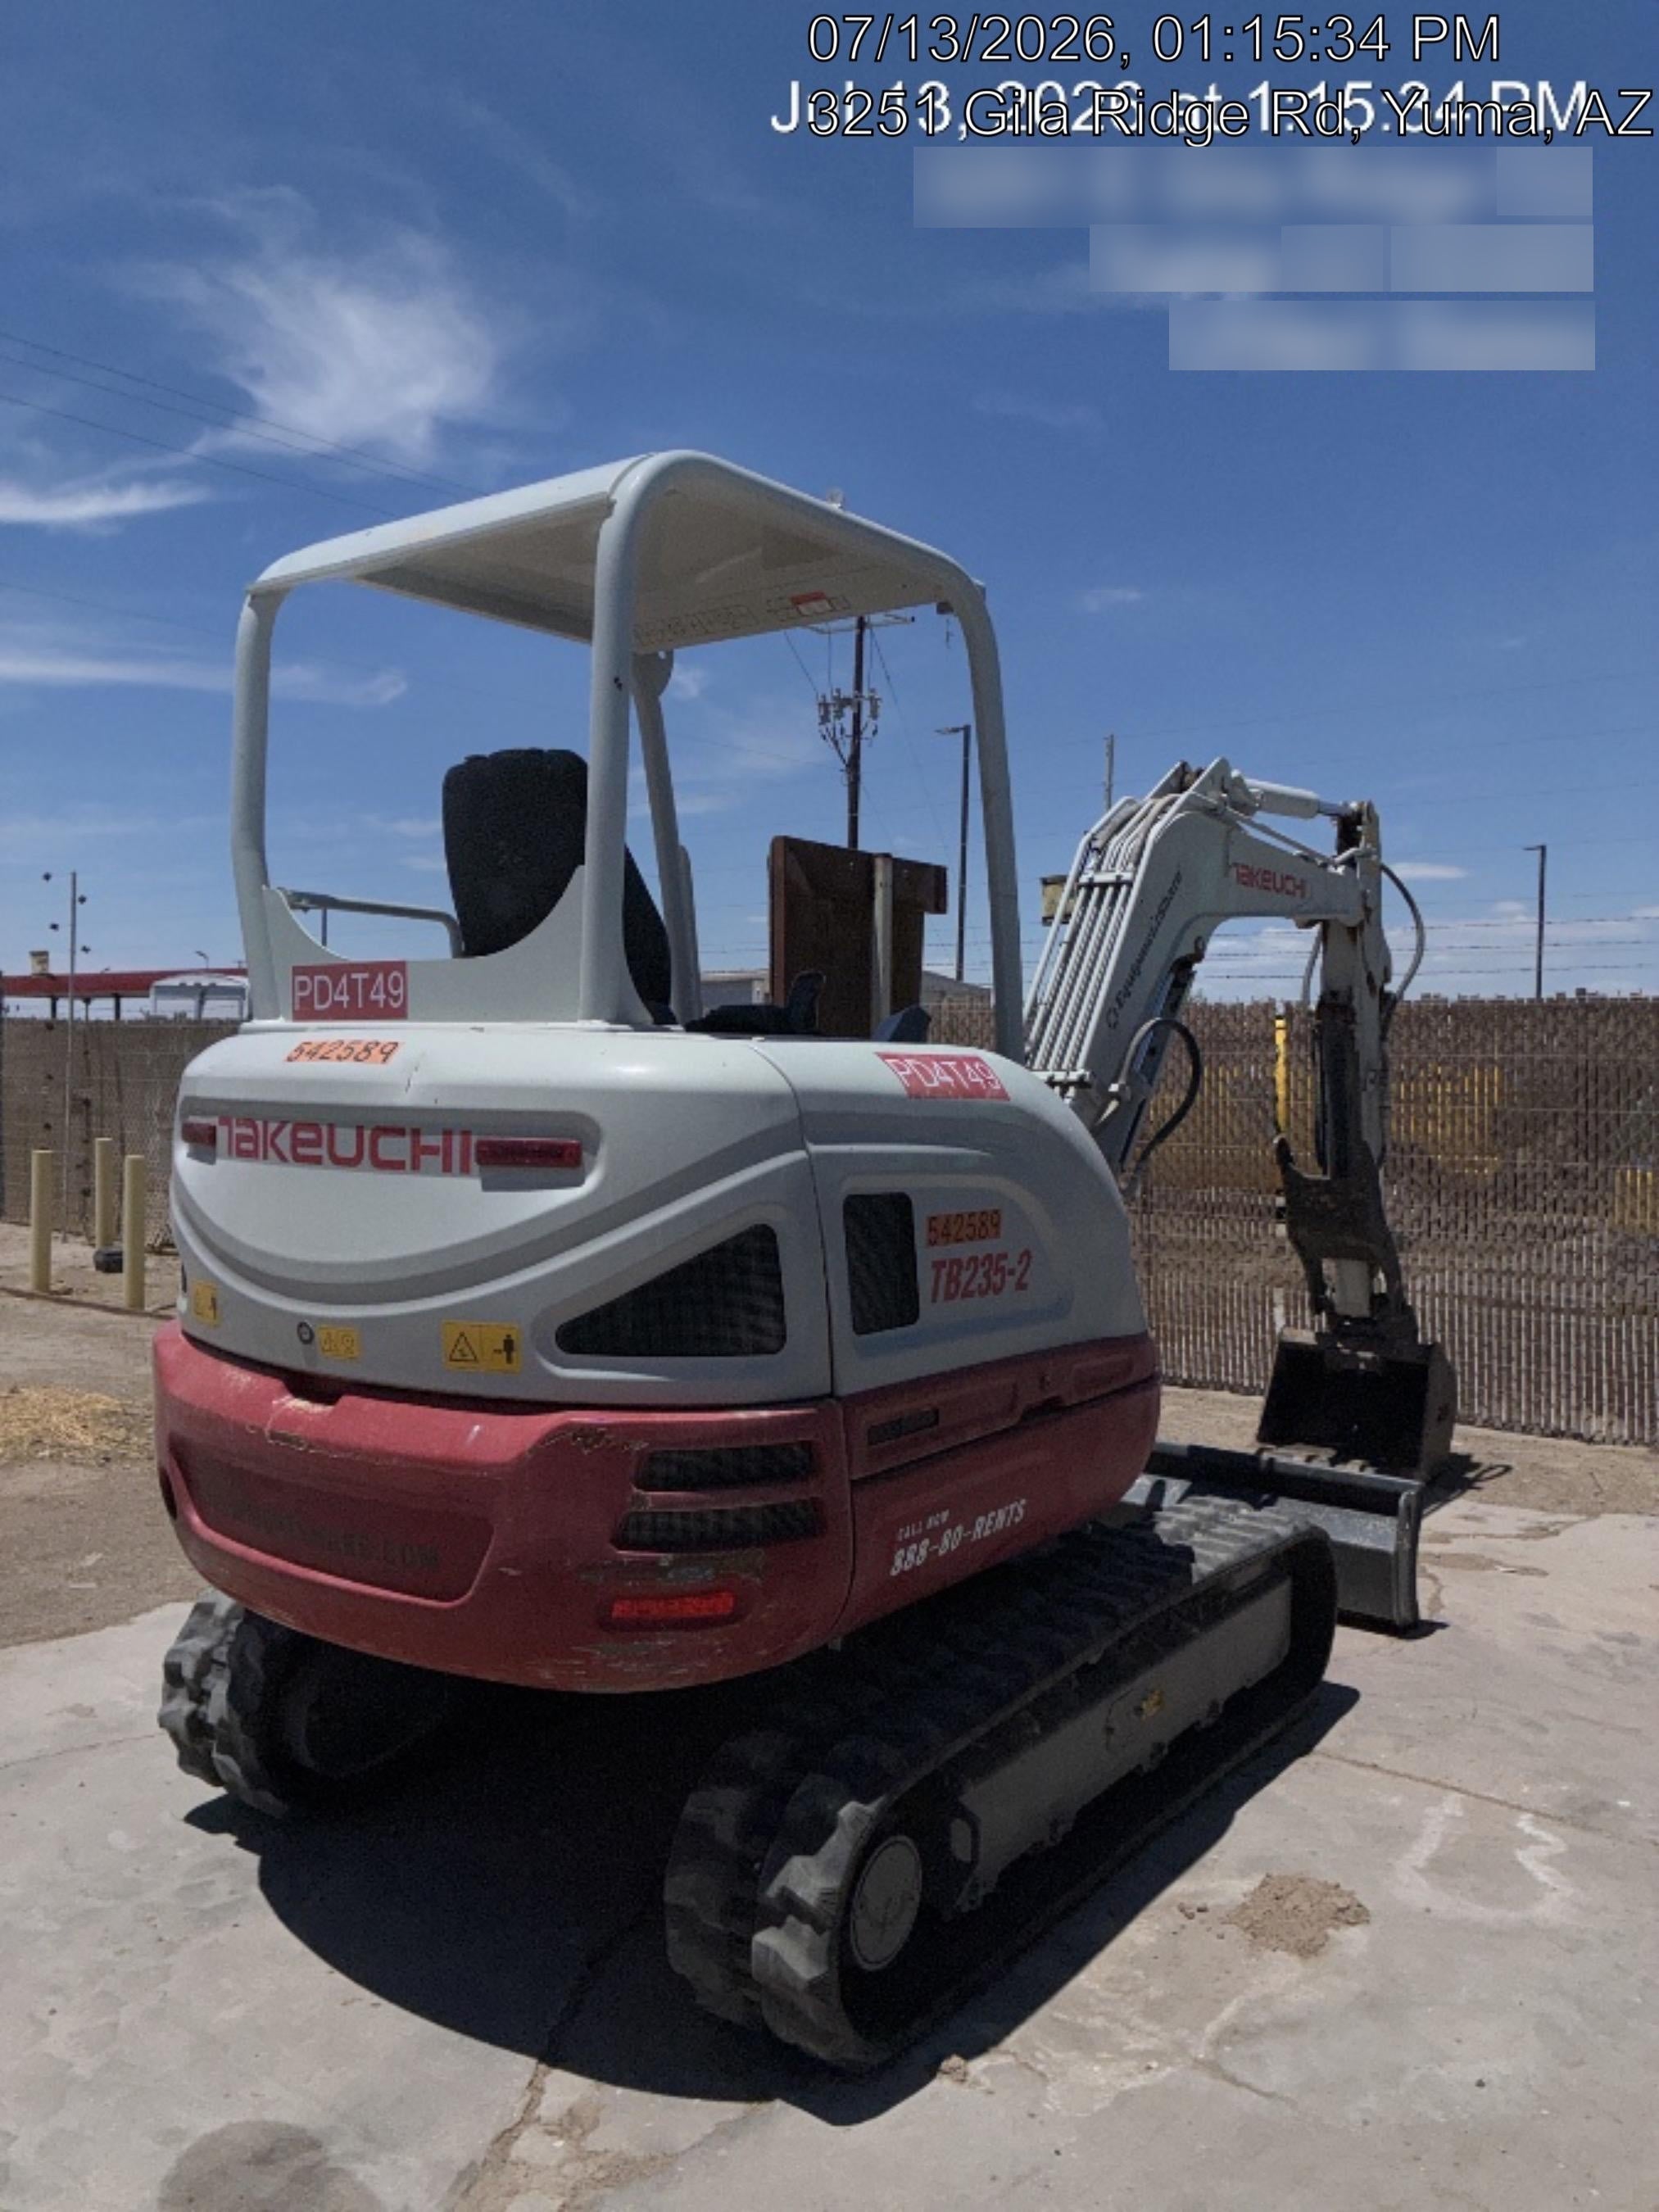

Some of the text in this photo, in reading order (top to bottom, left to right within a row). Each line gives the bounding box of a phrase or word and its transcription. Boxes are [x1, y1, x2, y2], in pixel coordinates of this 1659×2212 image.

[293, 970, 405, 1012] PD4T49
[286, 1040, 400, 1064] 542589
[884, 1058, 1001, 1090] PD4T49
[927, 1208, 1002, 1247] 542589
[930, 1249, 1033, 1304] TB235-2
